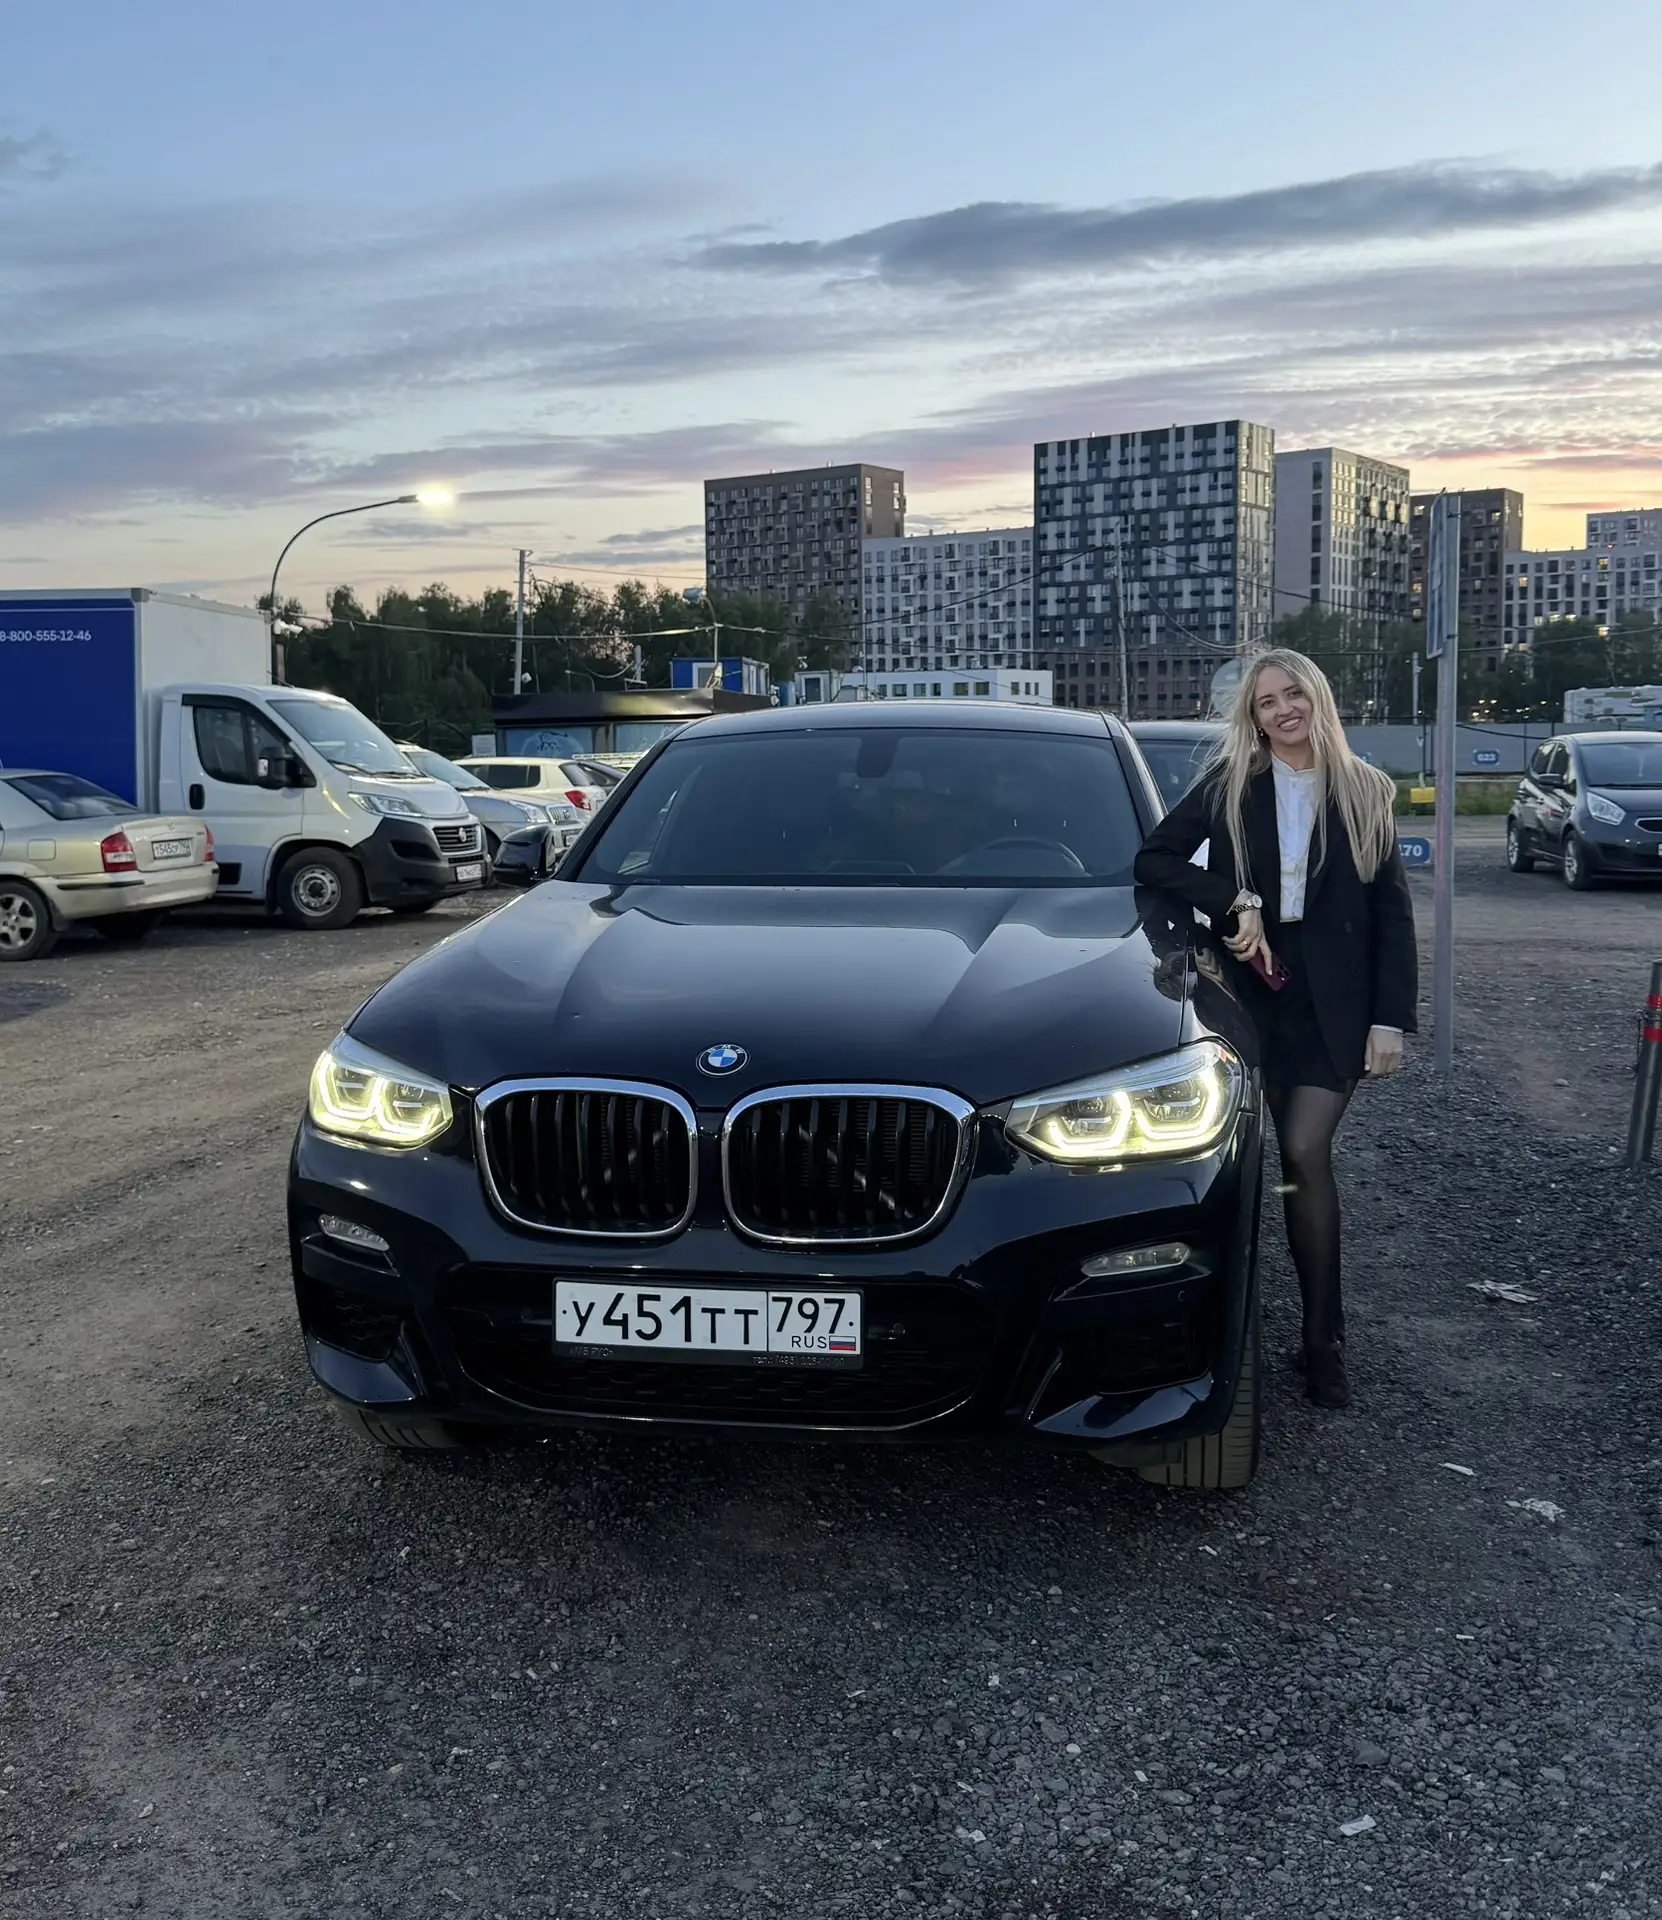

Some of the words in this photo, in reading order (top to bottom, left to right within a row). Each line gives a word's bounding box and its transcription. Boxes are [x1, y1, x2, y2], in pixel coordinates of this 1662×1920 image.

[0, 630, 91, 641] 8-800-555-12-46
[572, 1292, 759, 1345] У451ТТ
[771, 1296, 847, 1335] 797
[791, 1335, 827, 1349] RUS
